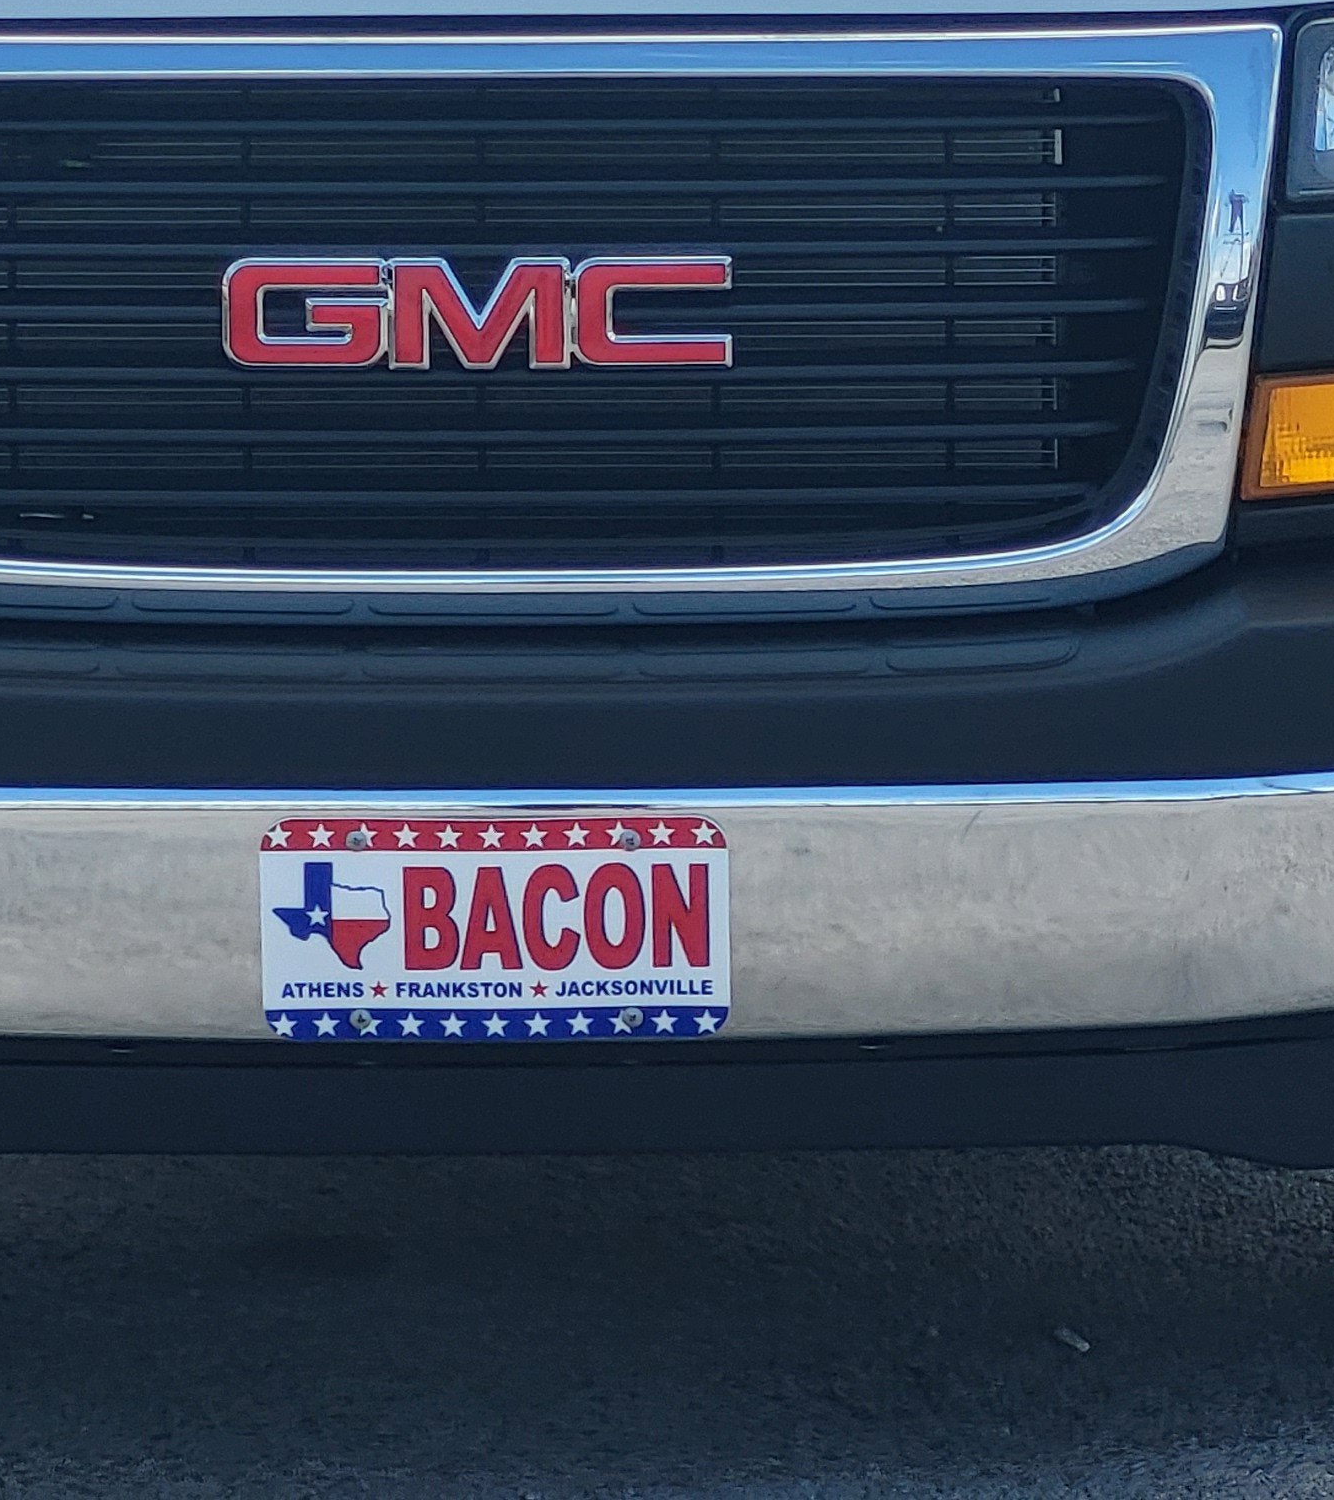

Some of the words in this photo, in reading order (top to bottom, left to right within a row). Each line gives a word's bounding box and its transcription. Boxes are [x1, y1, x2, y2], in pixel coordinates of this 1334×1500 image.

[221, 256, 734, 369] GMC
[402, 862, 710, 971] BACON
[281, 982, 365, 999] ATHENS
[395, 981, 523, 998] FRANKSTON
[555, 979, 714, 997] JACKSONVILLE
